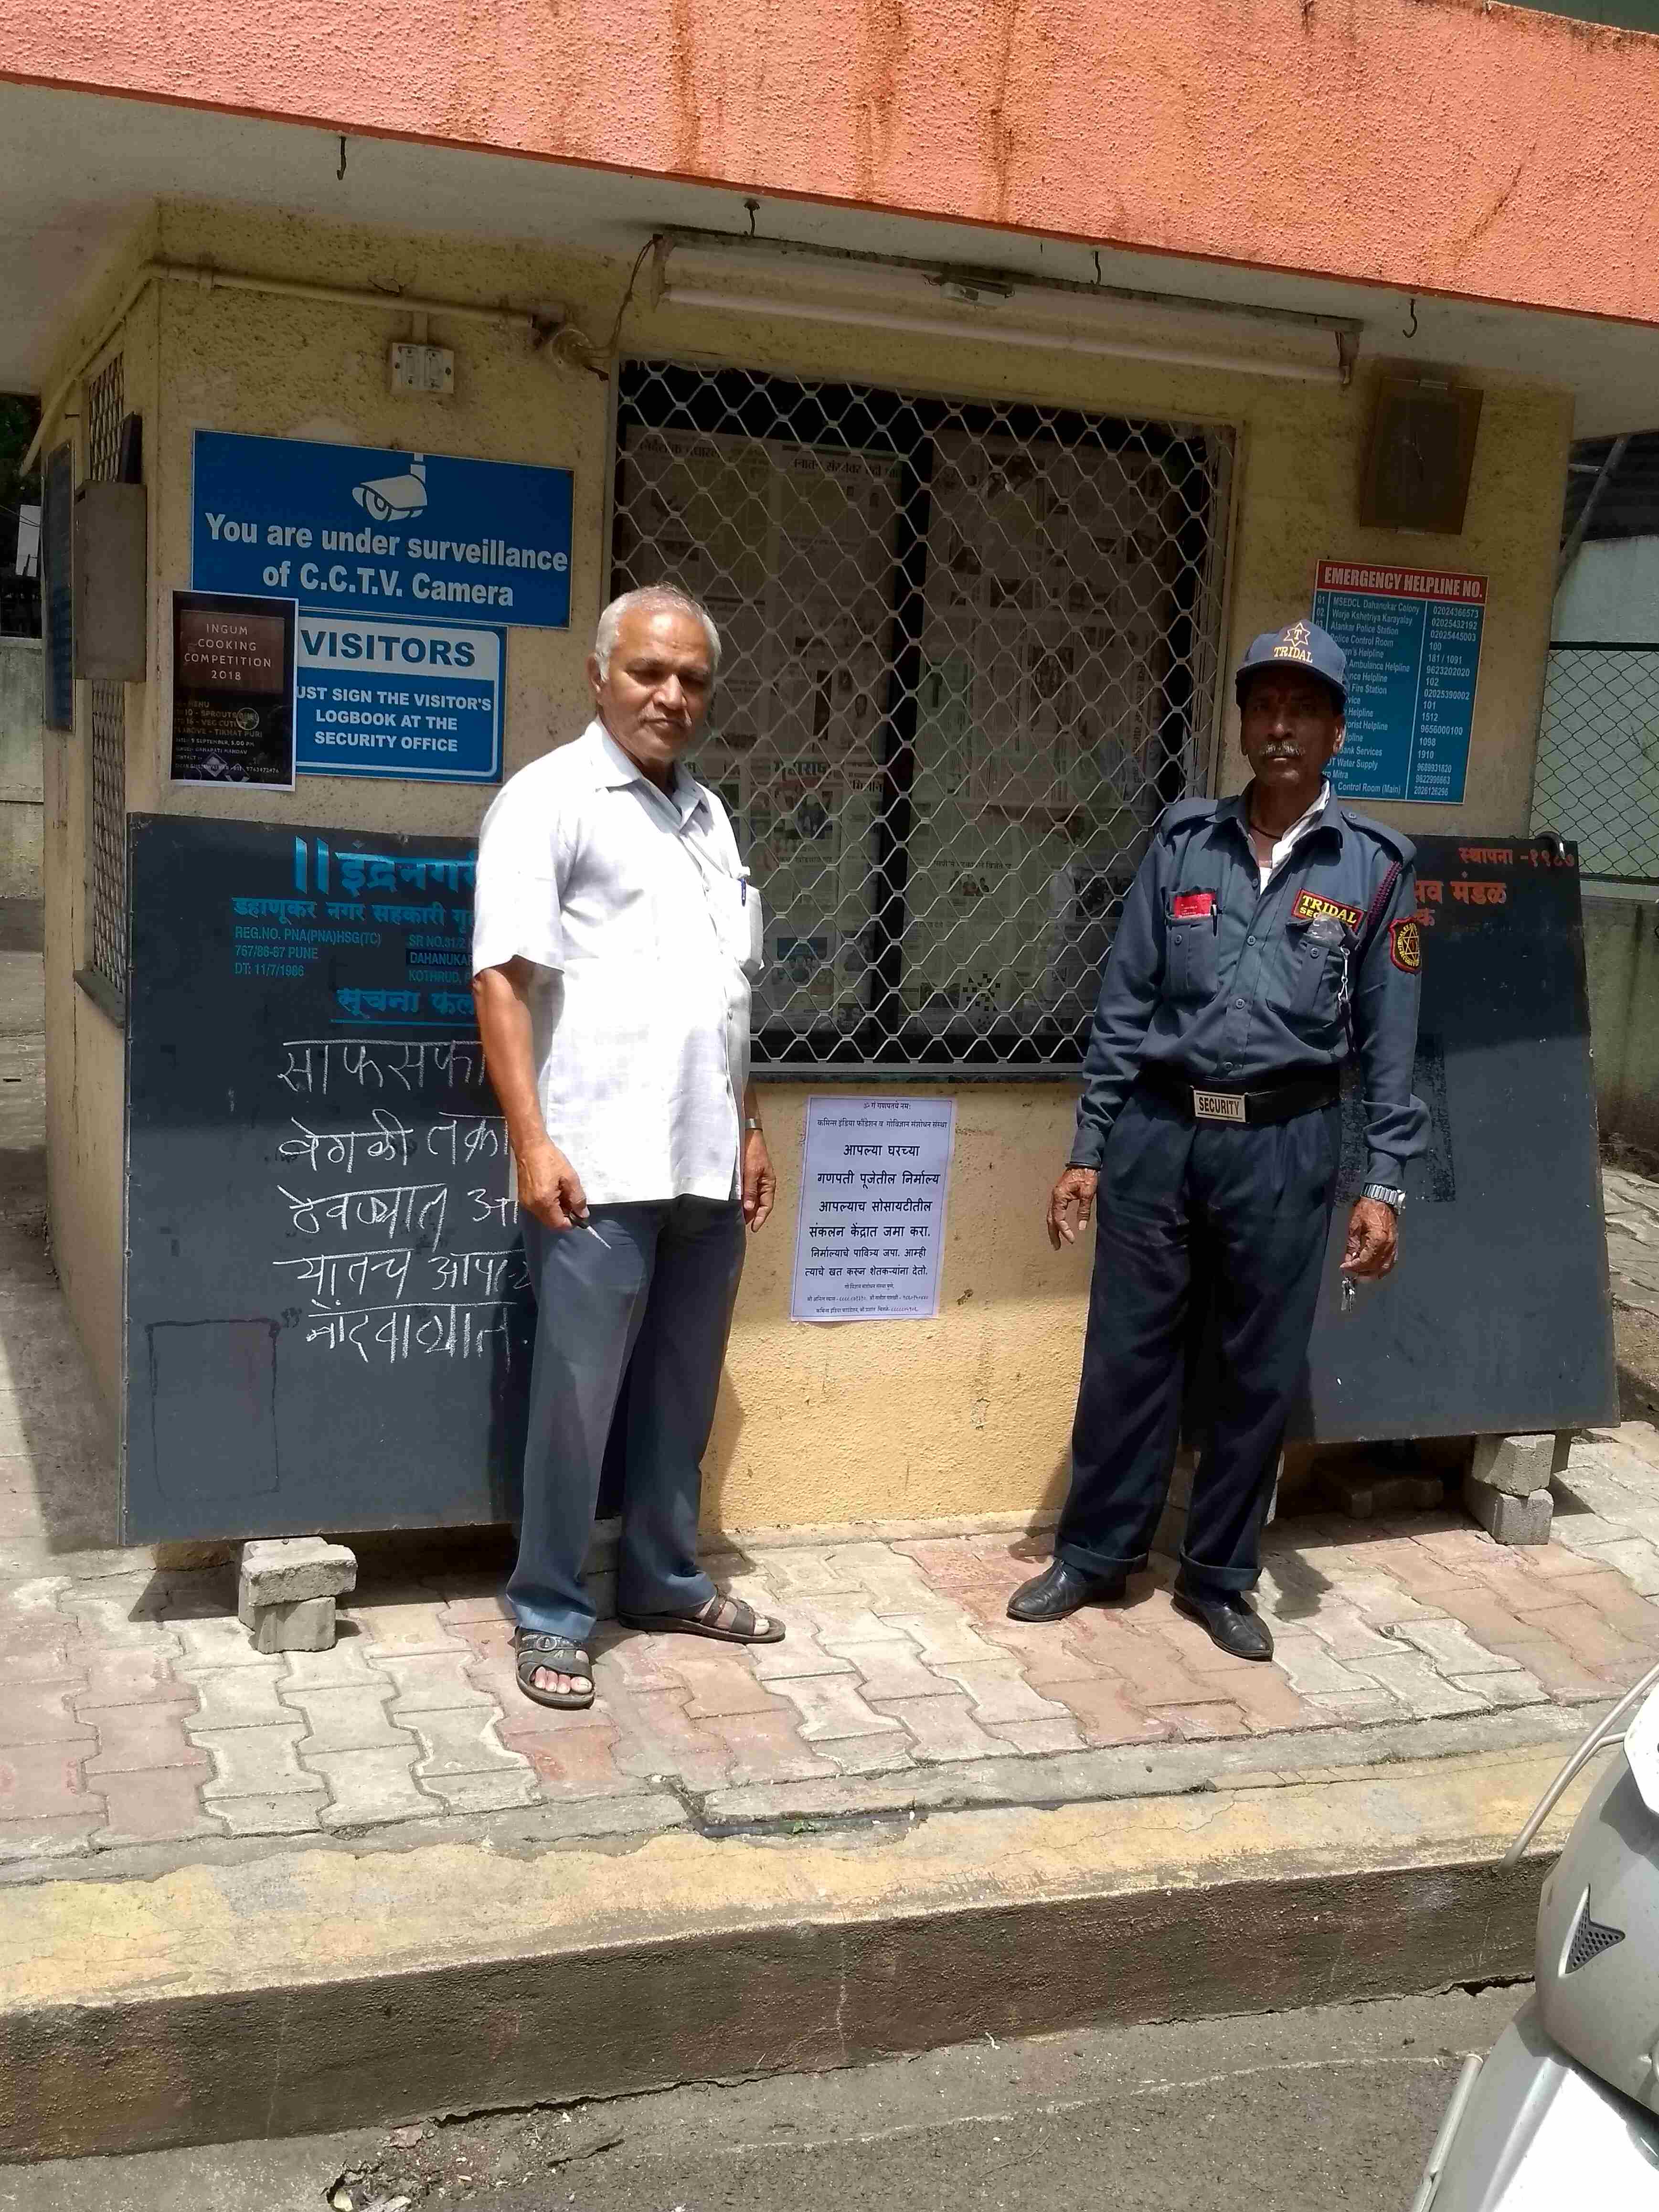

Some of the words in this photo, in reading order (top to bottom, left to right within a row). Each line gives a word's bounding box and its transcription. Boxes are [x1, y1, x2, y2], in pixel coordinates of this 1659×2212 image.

[205, 512, 257, 543] You
[267, 524, 313, 548] are
[321, 527, 400, 556] under
[407, 539, 568, 572] surveillance
[263, 560, 291, 587] of
[300, 562, 403, 597] C.C.T.V.
[412, 572, 513, 606] Camera
[1324, 566, 1402, 589] EMERGENCY
[1404, 574, 1460, 596] HELPLINE
[1462, 581, 1483, 598] NO.
[1333, 596, 1361, 607] MSEDCL
[1363, 600, 1397, 609] Dahanukar
[1398, 602, 1420, 615] Colony
[1332, 608, 1351, 620] Warje
[1351, 610, 1381, 623] Kshetriya
[206, 623, 248, 635] INGUM
[1330, 621, 1355, 631] Alankar
[1356, 623, 1376, 634] Police
[1377, 625, 1399, 635] Station
[198, 638, 256, 651] COOKING
[300, 629, 476, 668] VISITORS
[1351, 635, 1373, 645] Control
[1375, 638, 1394, 647] Room
[1429, 642, 1442, 651] 100
[184, 653, 272, 668] COMPETITION
[1274, 646, 1313, 663] TRIDAL
[1359, 648, 1384, 659] Helpline
[1349, 659, 1383, 670] Ambulance
[1385, 662, 1410, 673] Helpline
[211, 670, 242, 681] 2018
[1362, 672, 1388, 683] Helpline
[1425, 677, 1439, 687] 102
[1351, 683, 1364, 693] Fire
[1365, 684, 1387, 694] Station
[297, 686, 327, 700] UST
[332, 688, 372, 702] SIGN
[376, 691, 409, 705] THE
[414, 694, 492, 711] VISITOR'S
[1423, 701, 1436, 710] 101
[316, 709, 396, 727] LOGBOOK
[401, 715, 421, 728] AT
[426, 717, 458, 731] THE
[1348, 708, 1374, 718] Helpline
[1362, 720, 1388, 731] Helpline
[314, 731, 397, 748] SECURITY
[401, 736, 458, 752] OFFICE
[1356, 746, 1382, 756] Services
[1418, 750, 1434, 759] 1910
[1337, 758, 1355, 767] Water
[1356, 759, 1378, 770] Supply
[1338, 782, 1361, 792] Control
[1362, 783, 1380, 792] Room
[1382, 784, 1401, 795] (Main)
[326, 901, 366, 921] नगर
[372, 901, 446, 925] सहकारी
[1301, 894, 1357, 924] TRIDAL
[287, 947, 319, 960] PUNE
[337, 988, 420, 1019] सूचना
[1198, 1096, 1240, 1116] SECURITY
[838, 1117, 855, 1127] इंडिया
[843, 1144, 883, 1157] आपल्या
[887, 1144, 921, 1158] घरच्या
[817, 1170, 855, 1185] गणपती
[859, 1170, 897, 1189] पूजेतील
[901, 1170, 941, 1185] निर्माल्य
[819, 1200, 867, 1212] आपल्याच
[872, 1198, 933, 1212] सोसायटीतील
[809, 1222, 845, 1238] संकलन
[850, 1222, 879, 1238] केंद्रात
[883, 1225, 905, 1238] जमा
[910, 1225, 931, 1238] करा.
[810, 1246, 850, 1258] निर्माल्याचे
[883, 1248, 901, 1258] जपा.
[904, 1247, 926, 1258] आम्ही
[805, 1266, 825, 1277] त्याचे
[829, 1268, 842, 1277] खत
[846, 1268, 866, 1276] करून
[912, 1266, 928, 1276] देतो.
